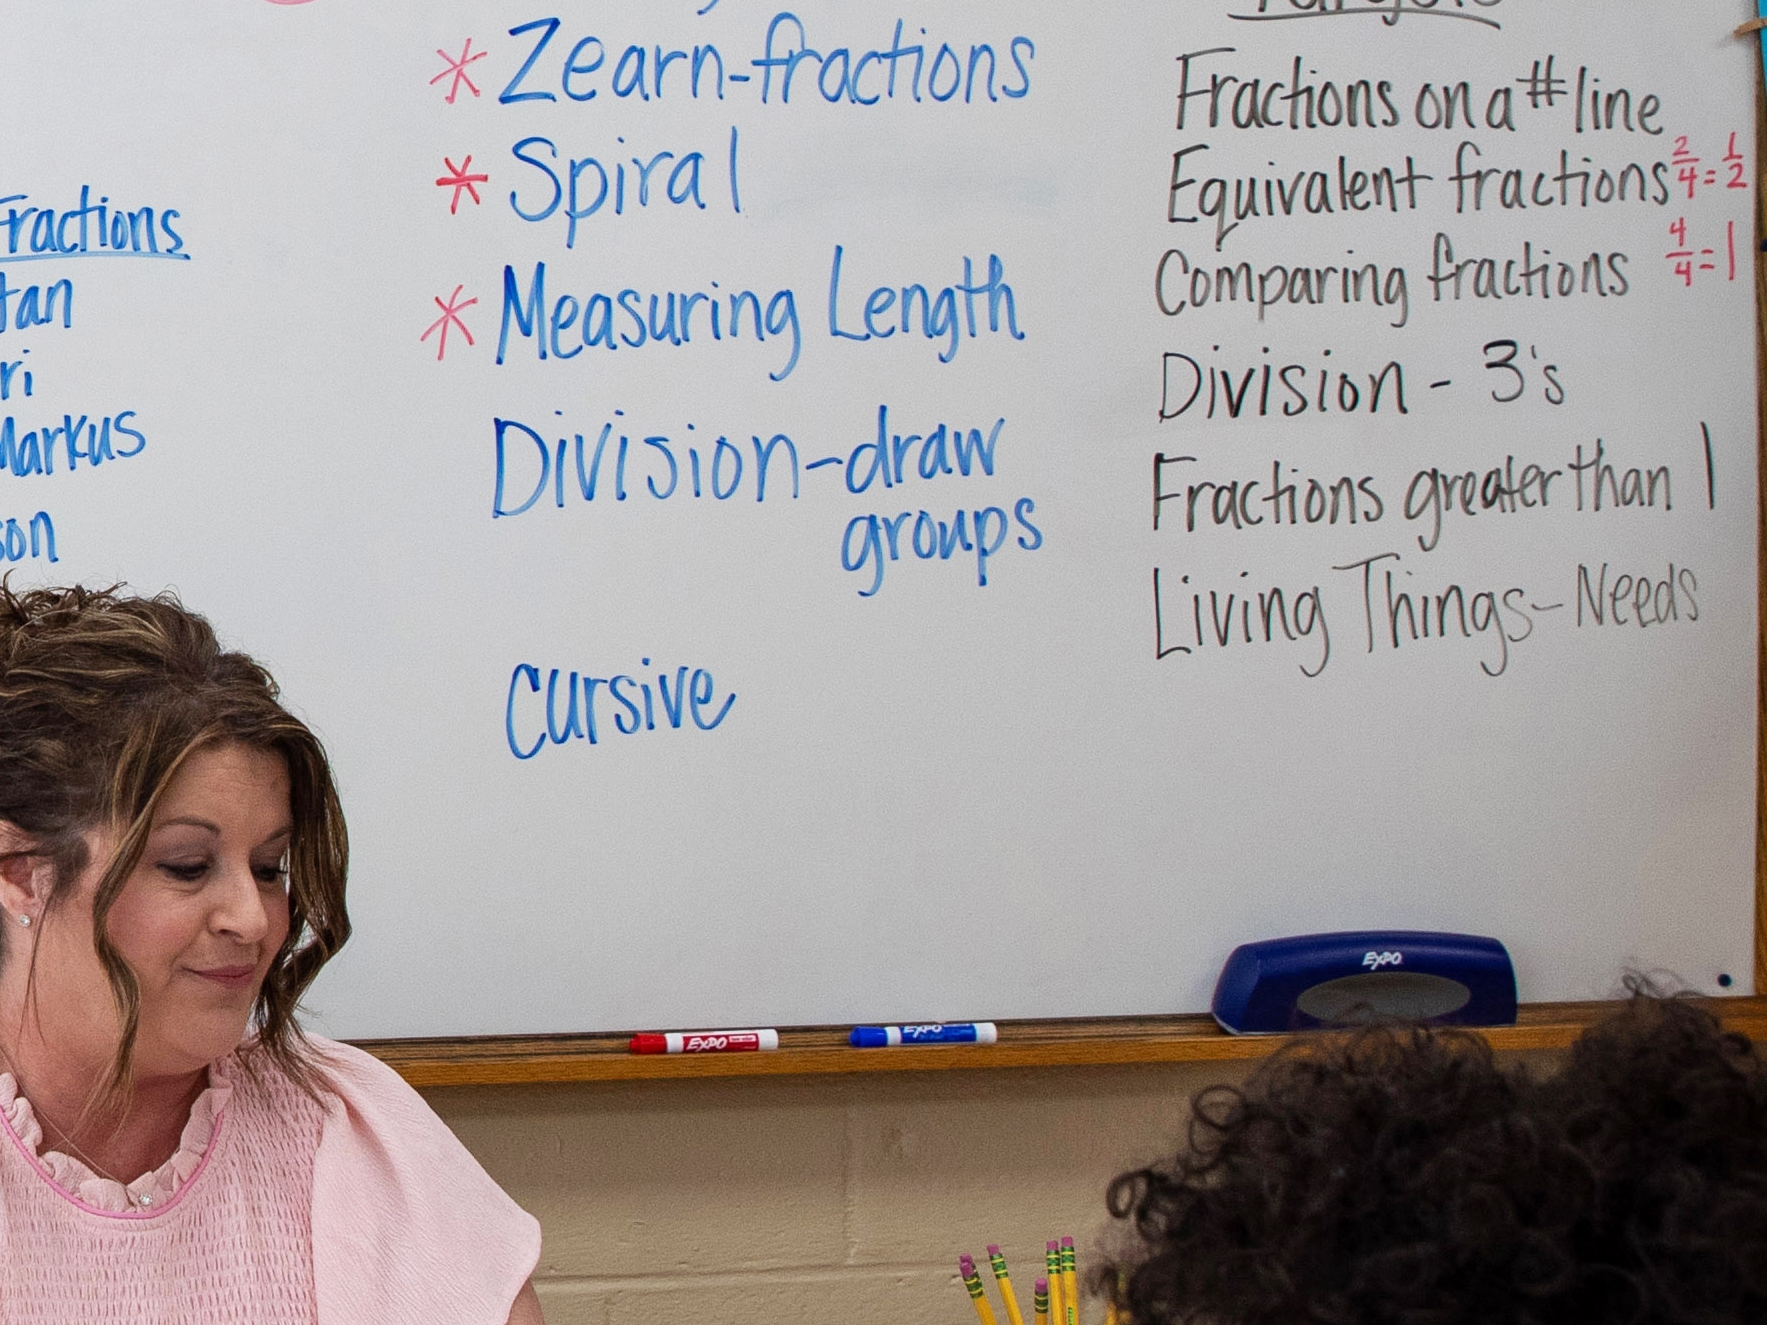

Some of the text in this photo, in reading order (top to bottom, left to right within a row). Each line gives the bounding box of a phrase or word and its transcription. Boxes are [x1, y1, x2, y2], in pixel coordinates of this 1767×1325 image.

[1175, 46, 1401, 131] Fractions
[1573, 65, 1665, 136] line
[507, 126, 743, 231] Spiral
[1167, 141, 1670, 252] Equivalent fractions
[495, 244, 1025, 382] Measuring Length
[1154, 232, 1629, 328] Comparing fractions
[1158, 344, 1409, 423] Division
[1151, 452, 1384, 532] Fractions
[1402, 454, 1564, 552] greater
[1565, 438, 1672, 513] than
[840, 497, 1044, 597] groups
[1153, 567, 1331, 678] Living
[1362, 951, 1402, 970] EXPO
[686, 1037, 728, 1051] EXPO
